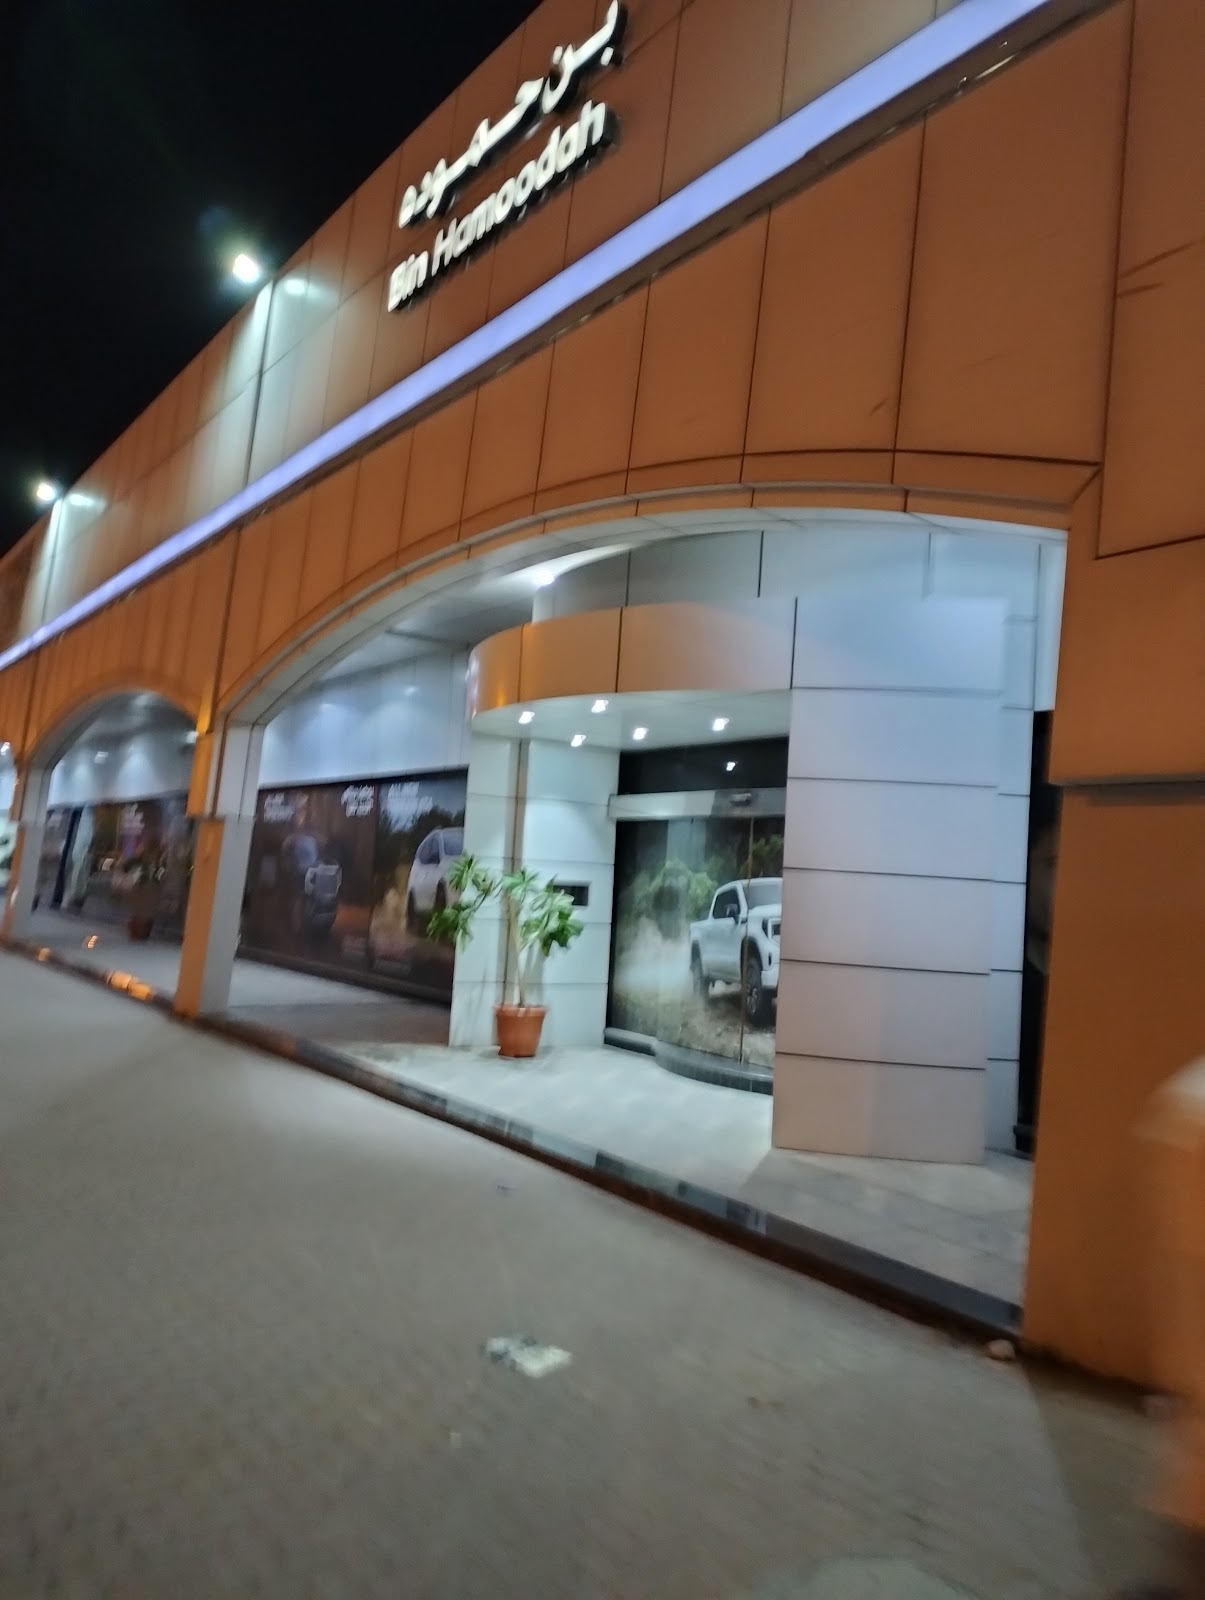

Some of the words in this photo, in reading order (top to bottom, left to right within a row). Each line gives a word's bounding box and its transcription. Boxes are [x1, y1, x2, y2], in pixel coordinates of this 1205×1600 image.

[542, 0, 619, 114] بن
[387, 250, 429, 312] Bin
[431, 100, 606, 277] Hamoodah
